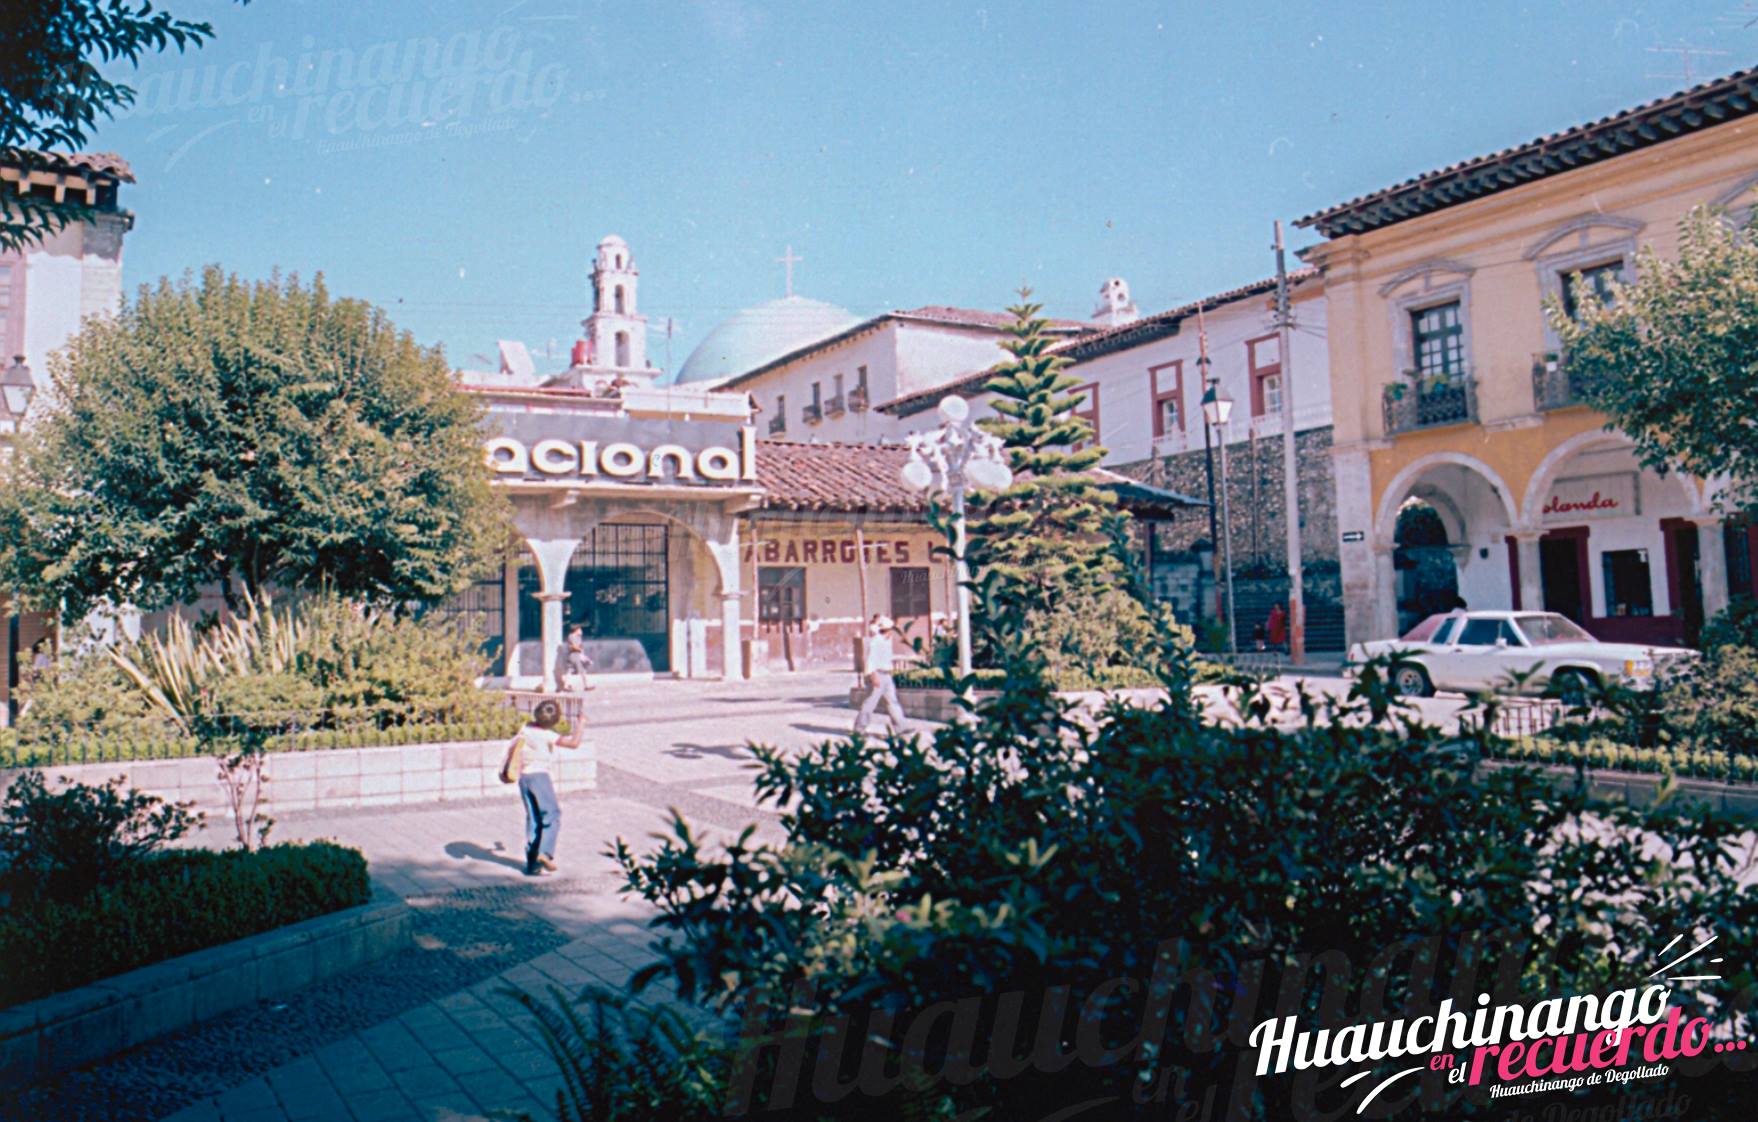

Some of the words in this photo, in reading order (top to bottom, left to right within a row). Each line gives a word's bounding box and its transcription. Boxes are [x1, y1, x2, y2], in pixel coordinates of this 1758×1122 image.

[484, 425, 756, 481] acional
[1542, 491, 1619, 514] olanda
[744, 538, 910, 564] ABARROTES
